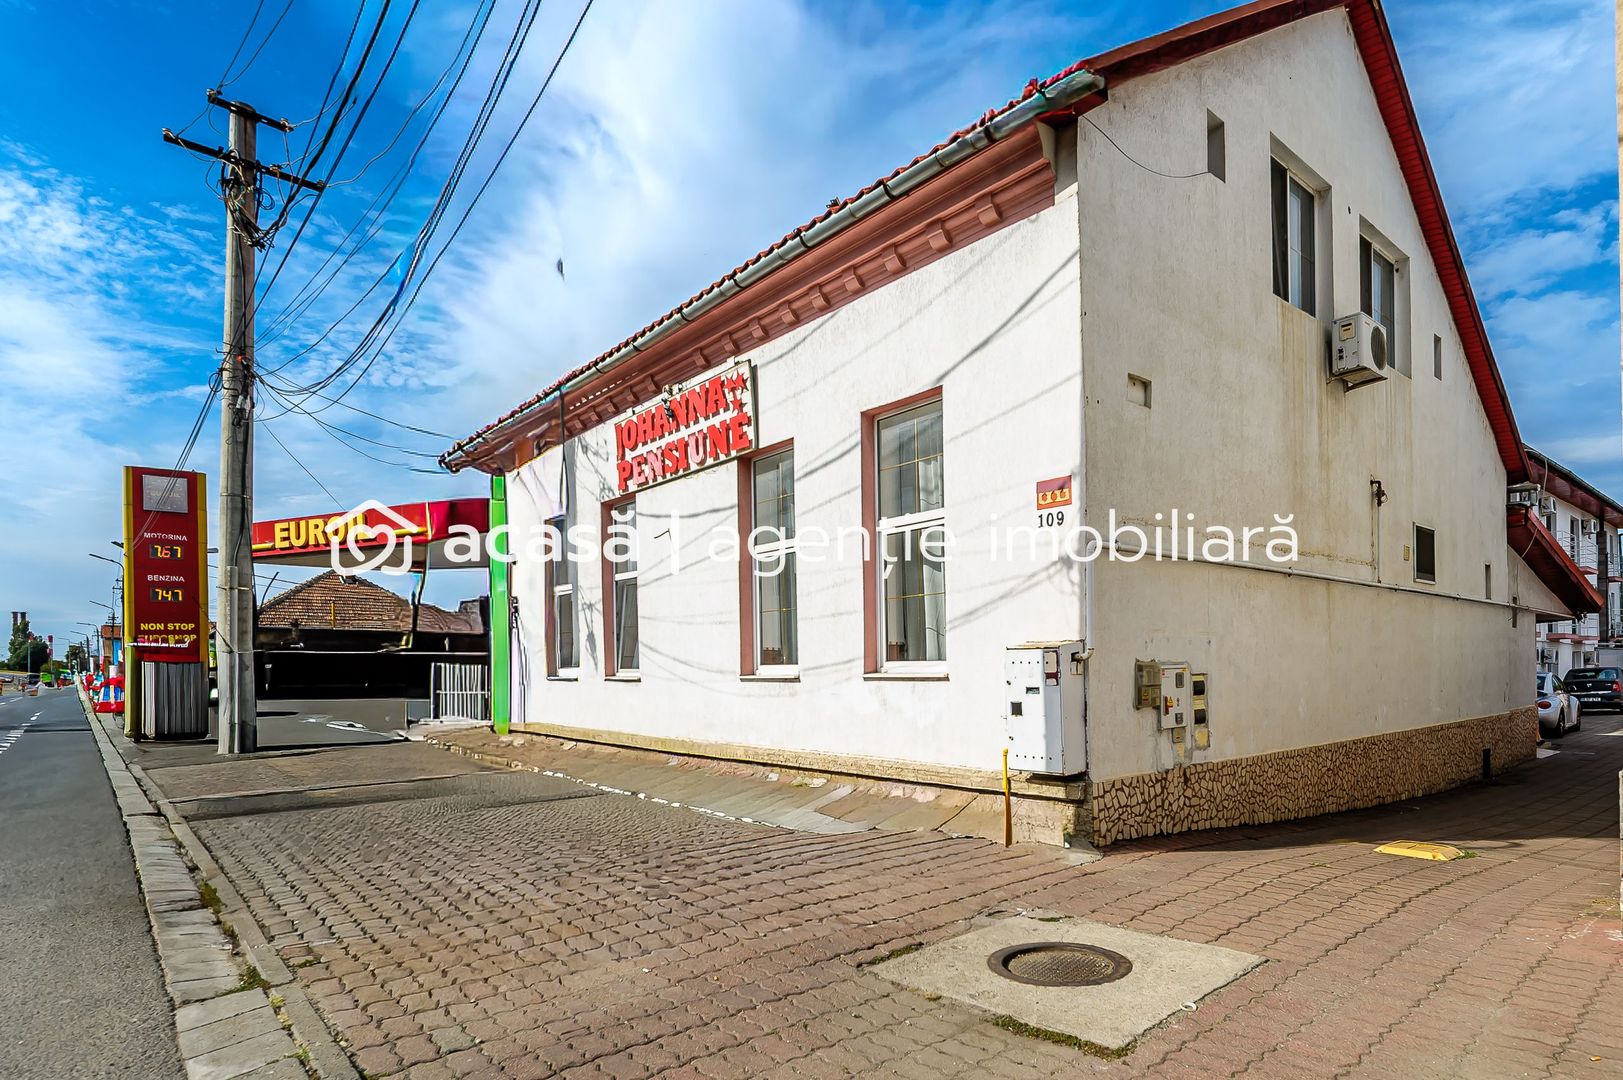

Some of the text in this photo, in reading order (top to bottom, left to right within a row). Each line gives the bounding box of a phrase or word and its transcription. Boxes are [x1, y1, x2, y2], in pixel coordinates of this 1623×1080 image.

[615, 376, 727, 460] JOHANNA
[617, 412, 751, 491] PENSIUNE
[1038, 511, 1065, 528] 109
[143, 532, 188, 542] MOTORINA
[274, 513, 376, 549] EUROIL
[147, 574, 185, 582] BENZINA
[140, 623, 195, 631] NON STOP
